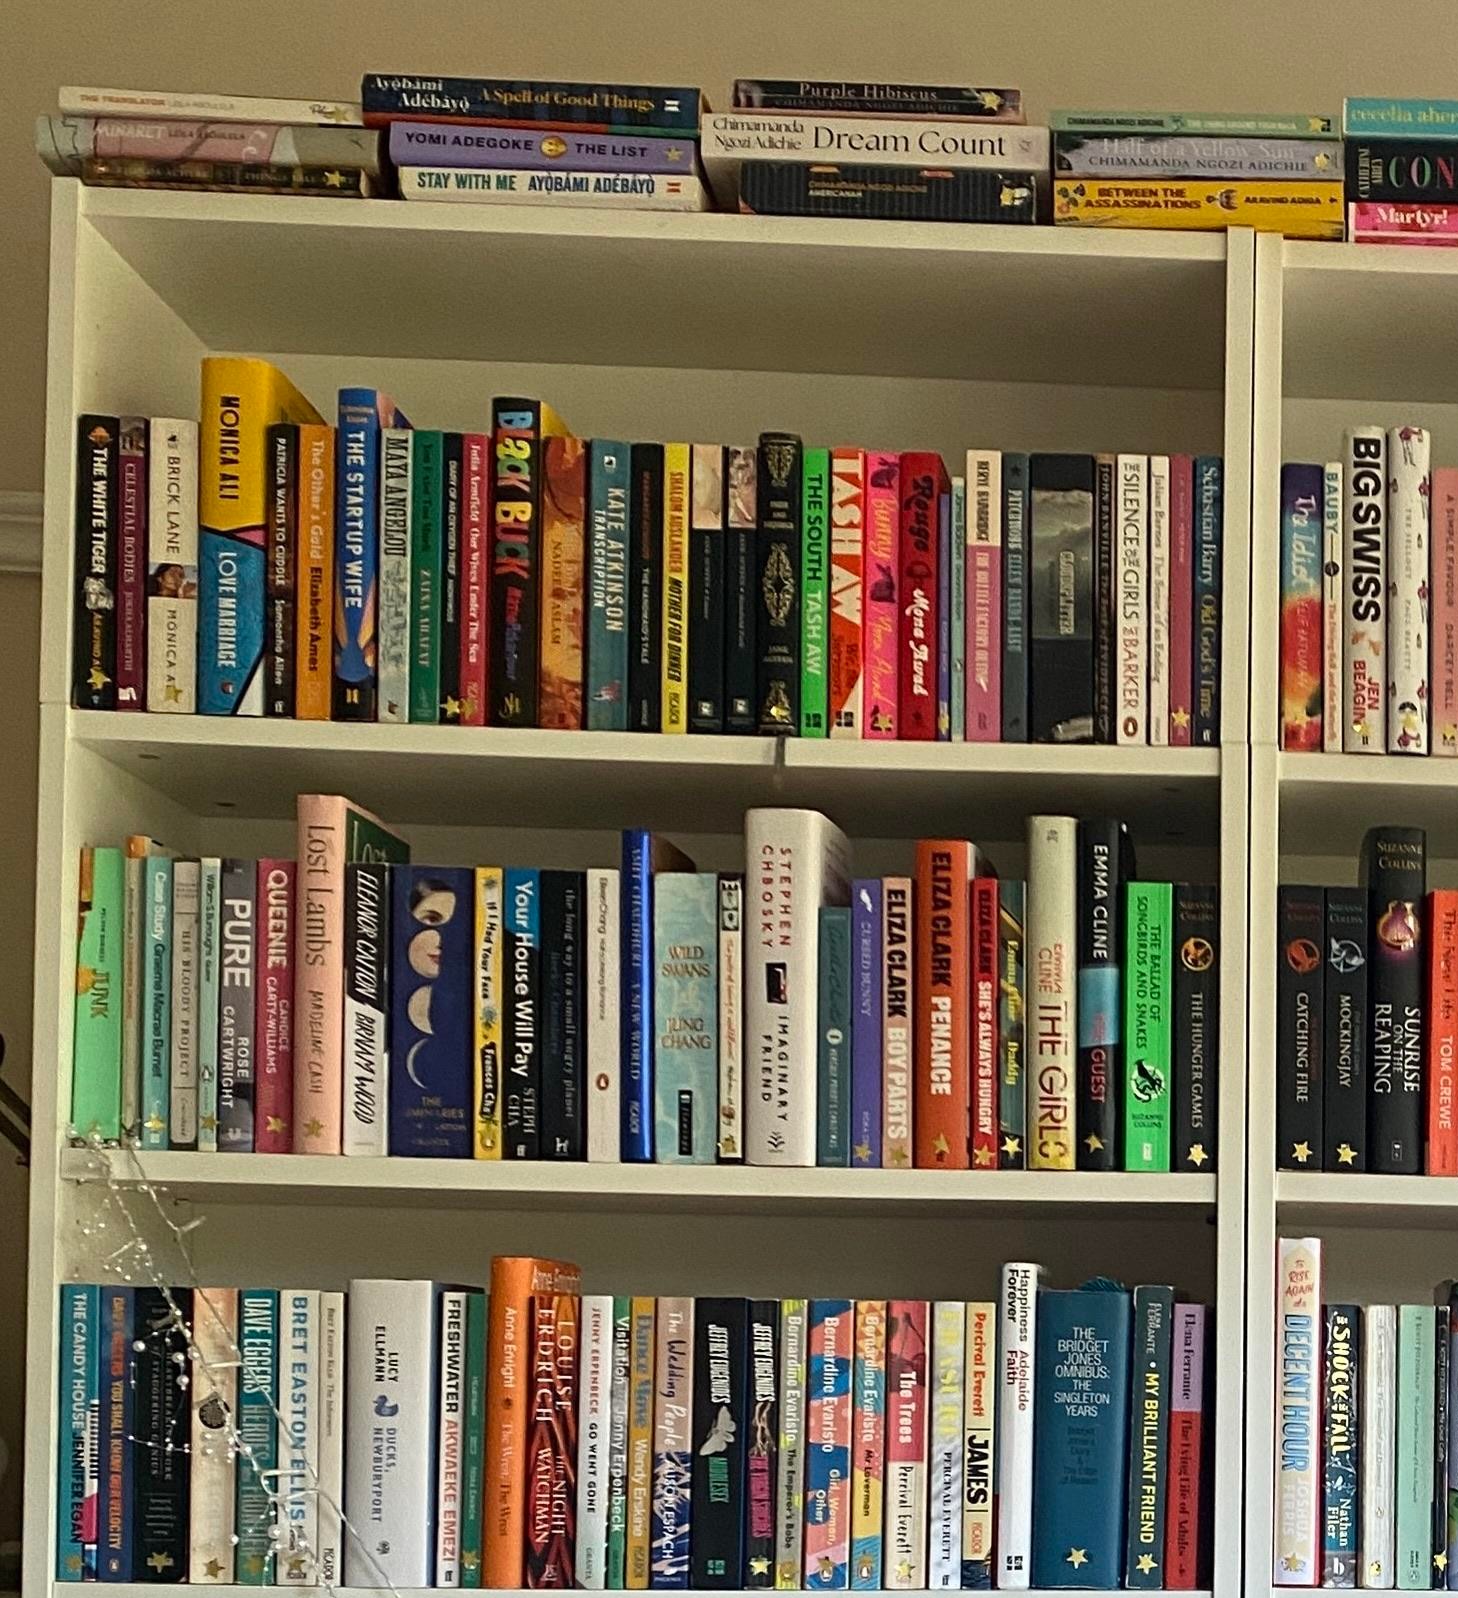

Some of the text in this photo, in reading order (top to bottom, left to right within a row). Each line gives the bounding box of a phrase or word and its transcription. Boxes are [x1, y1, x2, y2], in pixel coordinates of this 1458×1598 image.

[406, 133, 648, 158] YOMI ADEGOKE THE LIST
[418, 173, 516, 191] STAY WITH ME
[813, 126, 1005, 157] Dream Count
[220, 396, 239, 499] MONICA ALI
[92, 448, 108, 572] THE WHITE TIGER
[346, 431, 364, 608] THE STARTUP WIFE
[593, 509, 606, 607] TRANSCRIPTION
[1352, 437, 1380, 622] BIG SWISS
[606, 488, 625, 631] KATE ATKINSON
[223, 899, 251, 987] PURE
[510, 881, 533, 1077] Your House Will Pay
[221, 1005, 234, 1108] CARTWRIGHT
[237, 1037, 249, 1078] ROSE
[761, 1035, 773, 1103] FRIEND
[776, 1015, 789, 1122] IMAGINARY
[1338, 995, 1351, 1087] MOCKINGJAY
[1373, 1003, 1391, 1093] REAPING
[1404, 1006, 1420, 1092] SUNRISE
[535, 1309, 554, 1422] ERDRICH
[557, 1320, 572, 1412] LOUISE
[443, 1299, 461, 1561] FRESHWATER AKWAEKE EMEZI
[968, 1435, 988, 1504] JAMES
[1140, 1373, 1159, 1543] MY BRILLIANT FRIEND
